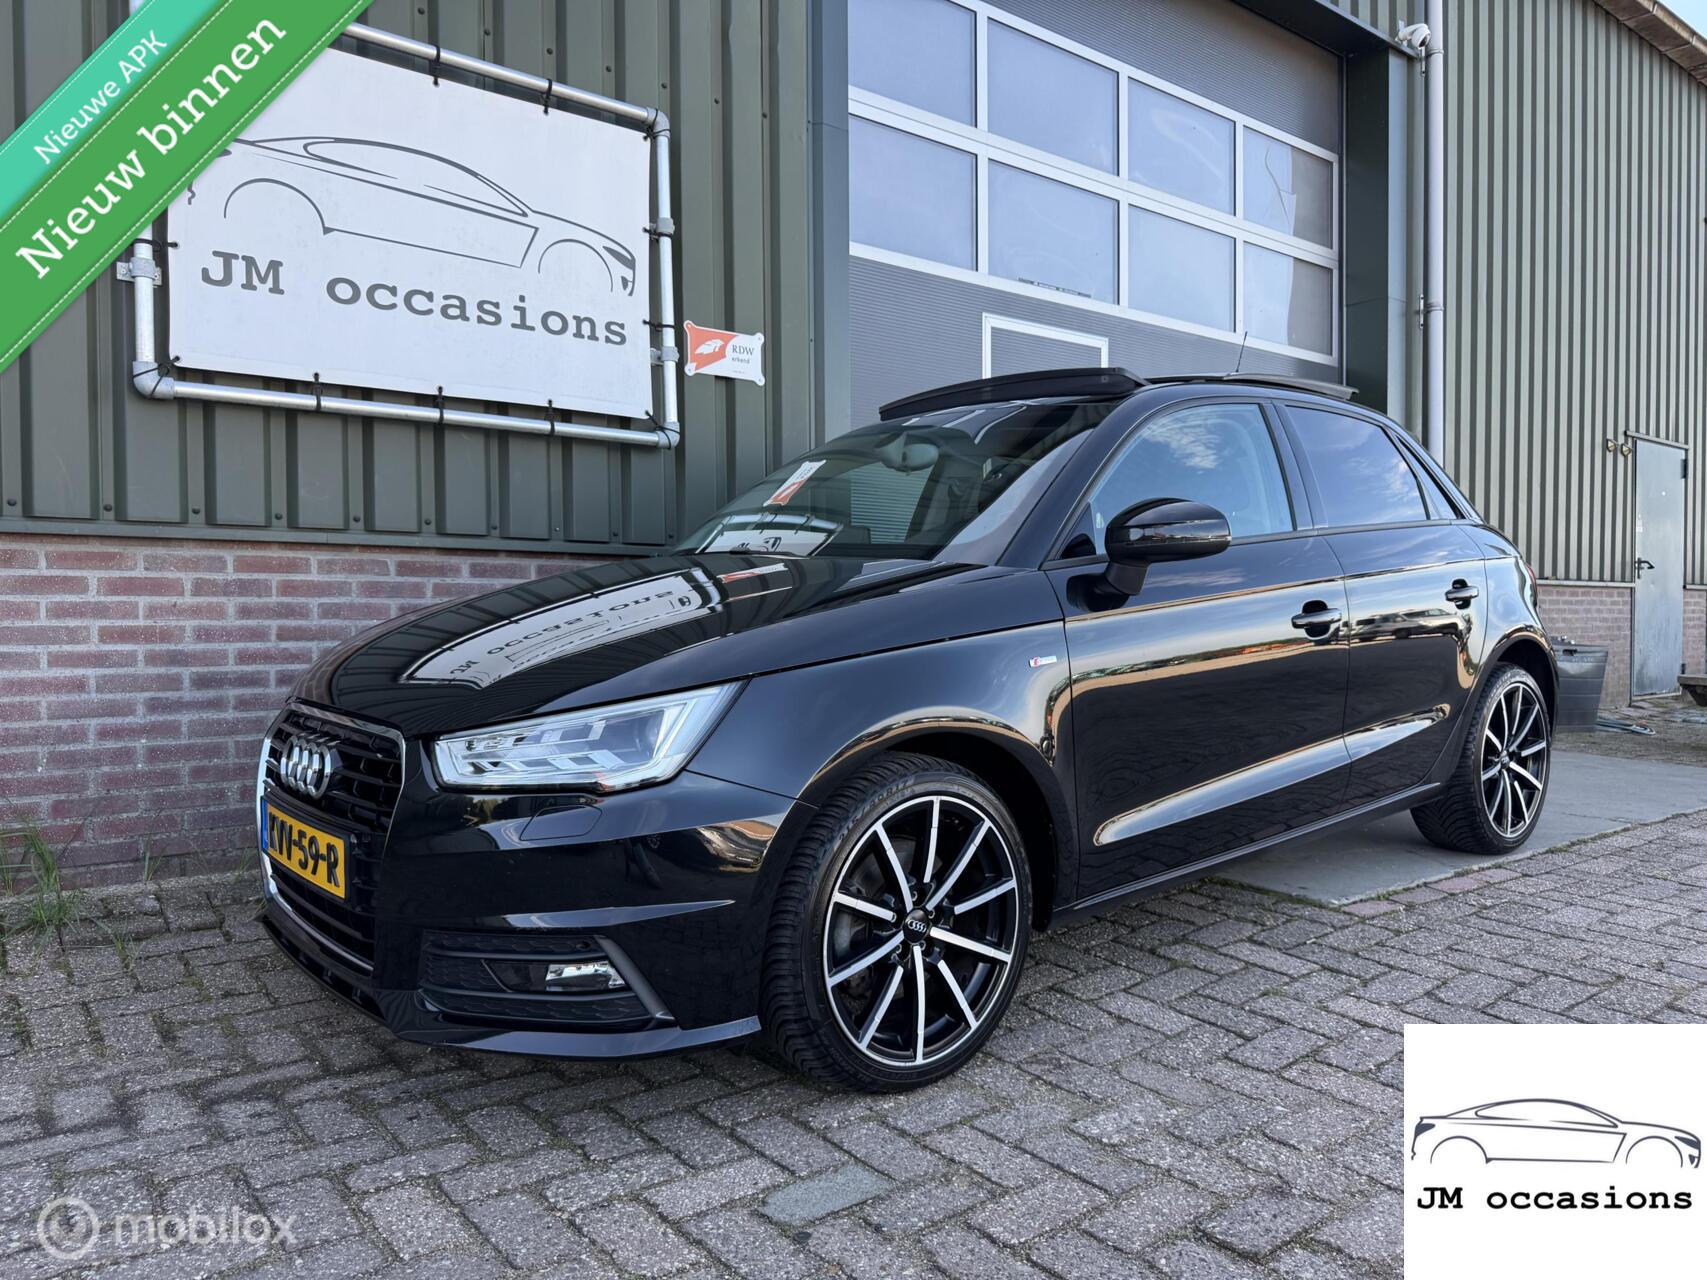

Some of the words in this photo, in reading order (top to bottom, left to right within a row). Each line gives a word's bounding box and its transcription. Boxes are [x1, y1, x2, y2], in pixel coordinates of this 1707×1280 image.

[201, 249, 285, 296] JM
[325, 275, 628, 347] occasions
[732, 344, 755, 356] RDW
